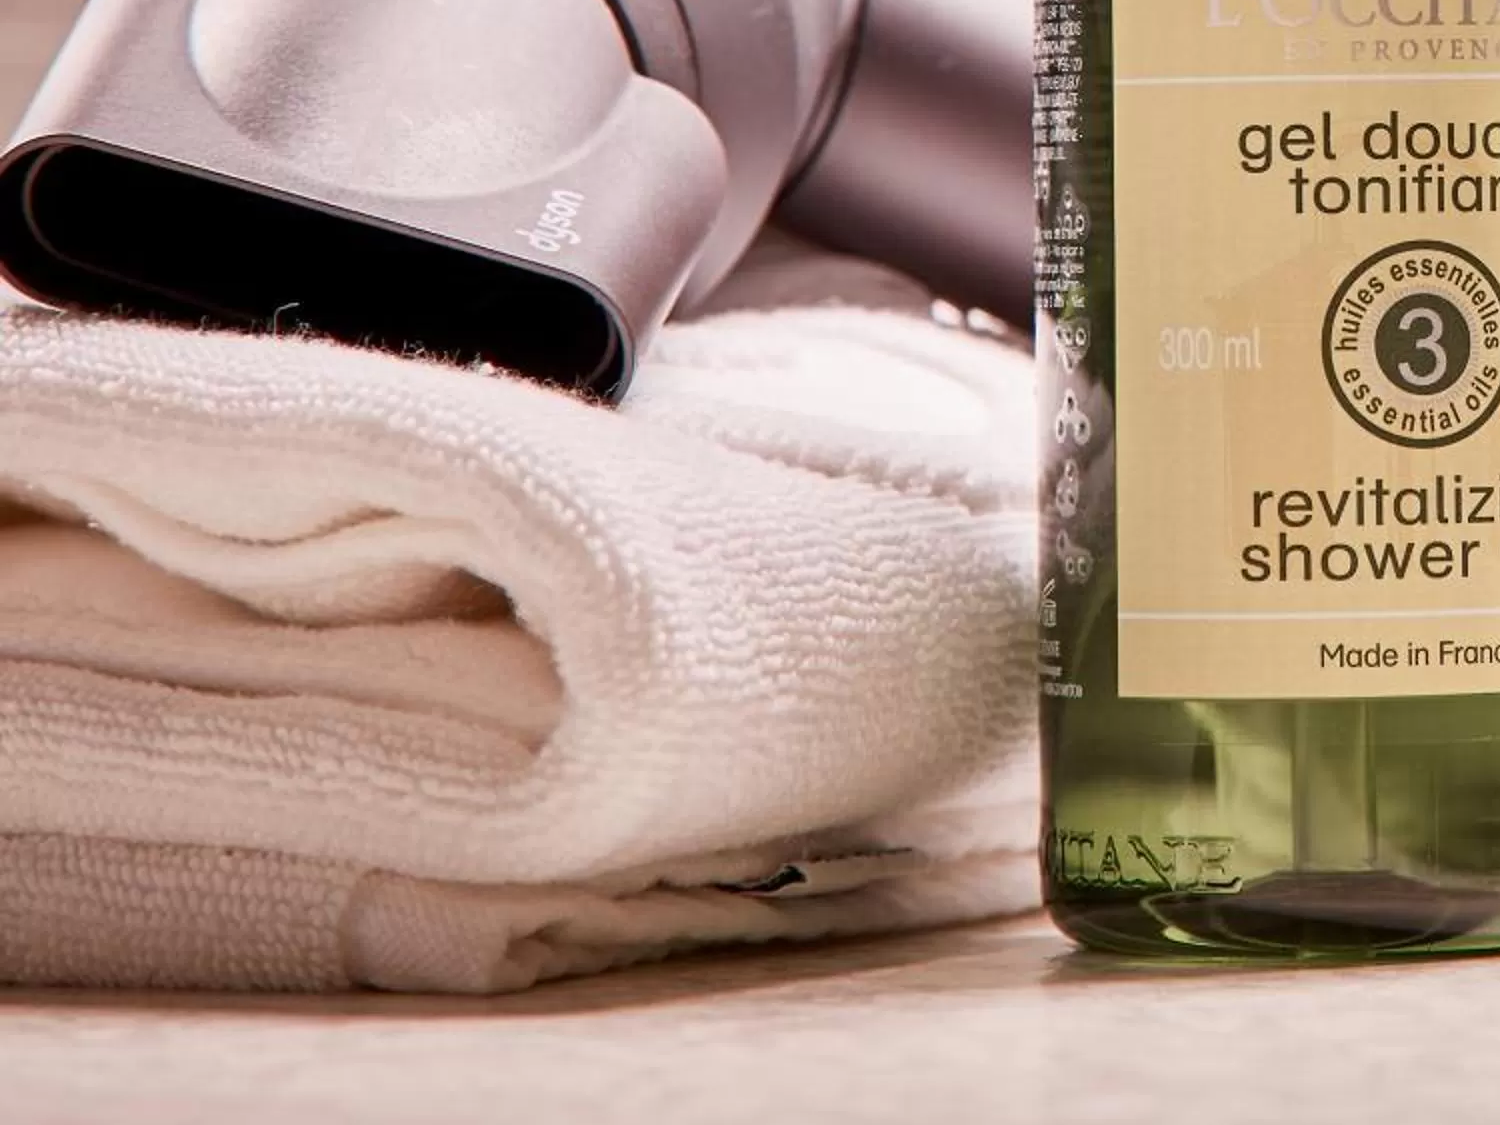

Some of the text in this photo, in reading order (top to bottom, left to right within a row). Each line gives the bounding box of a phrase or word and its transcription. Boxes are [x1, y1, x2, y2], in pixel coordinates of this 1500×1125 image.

[1238, 111, 1337, 173] gel
[514, 189, 584, 252] dyson
[1334, 276, 1386, 352] huiles
[1390, 258, 1500, 351] essentielles
[1159, 327, 1261, 371] 300 ml
[1397, 306, 1448, 387] 3
[1343, 365, 1498, 434] essential oils
[1240, 531, 1480, 582] shower
[1320, 642, 1398, 669] Made
[1407, 642, 1429, 666] in
